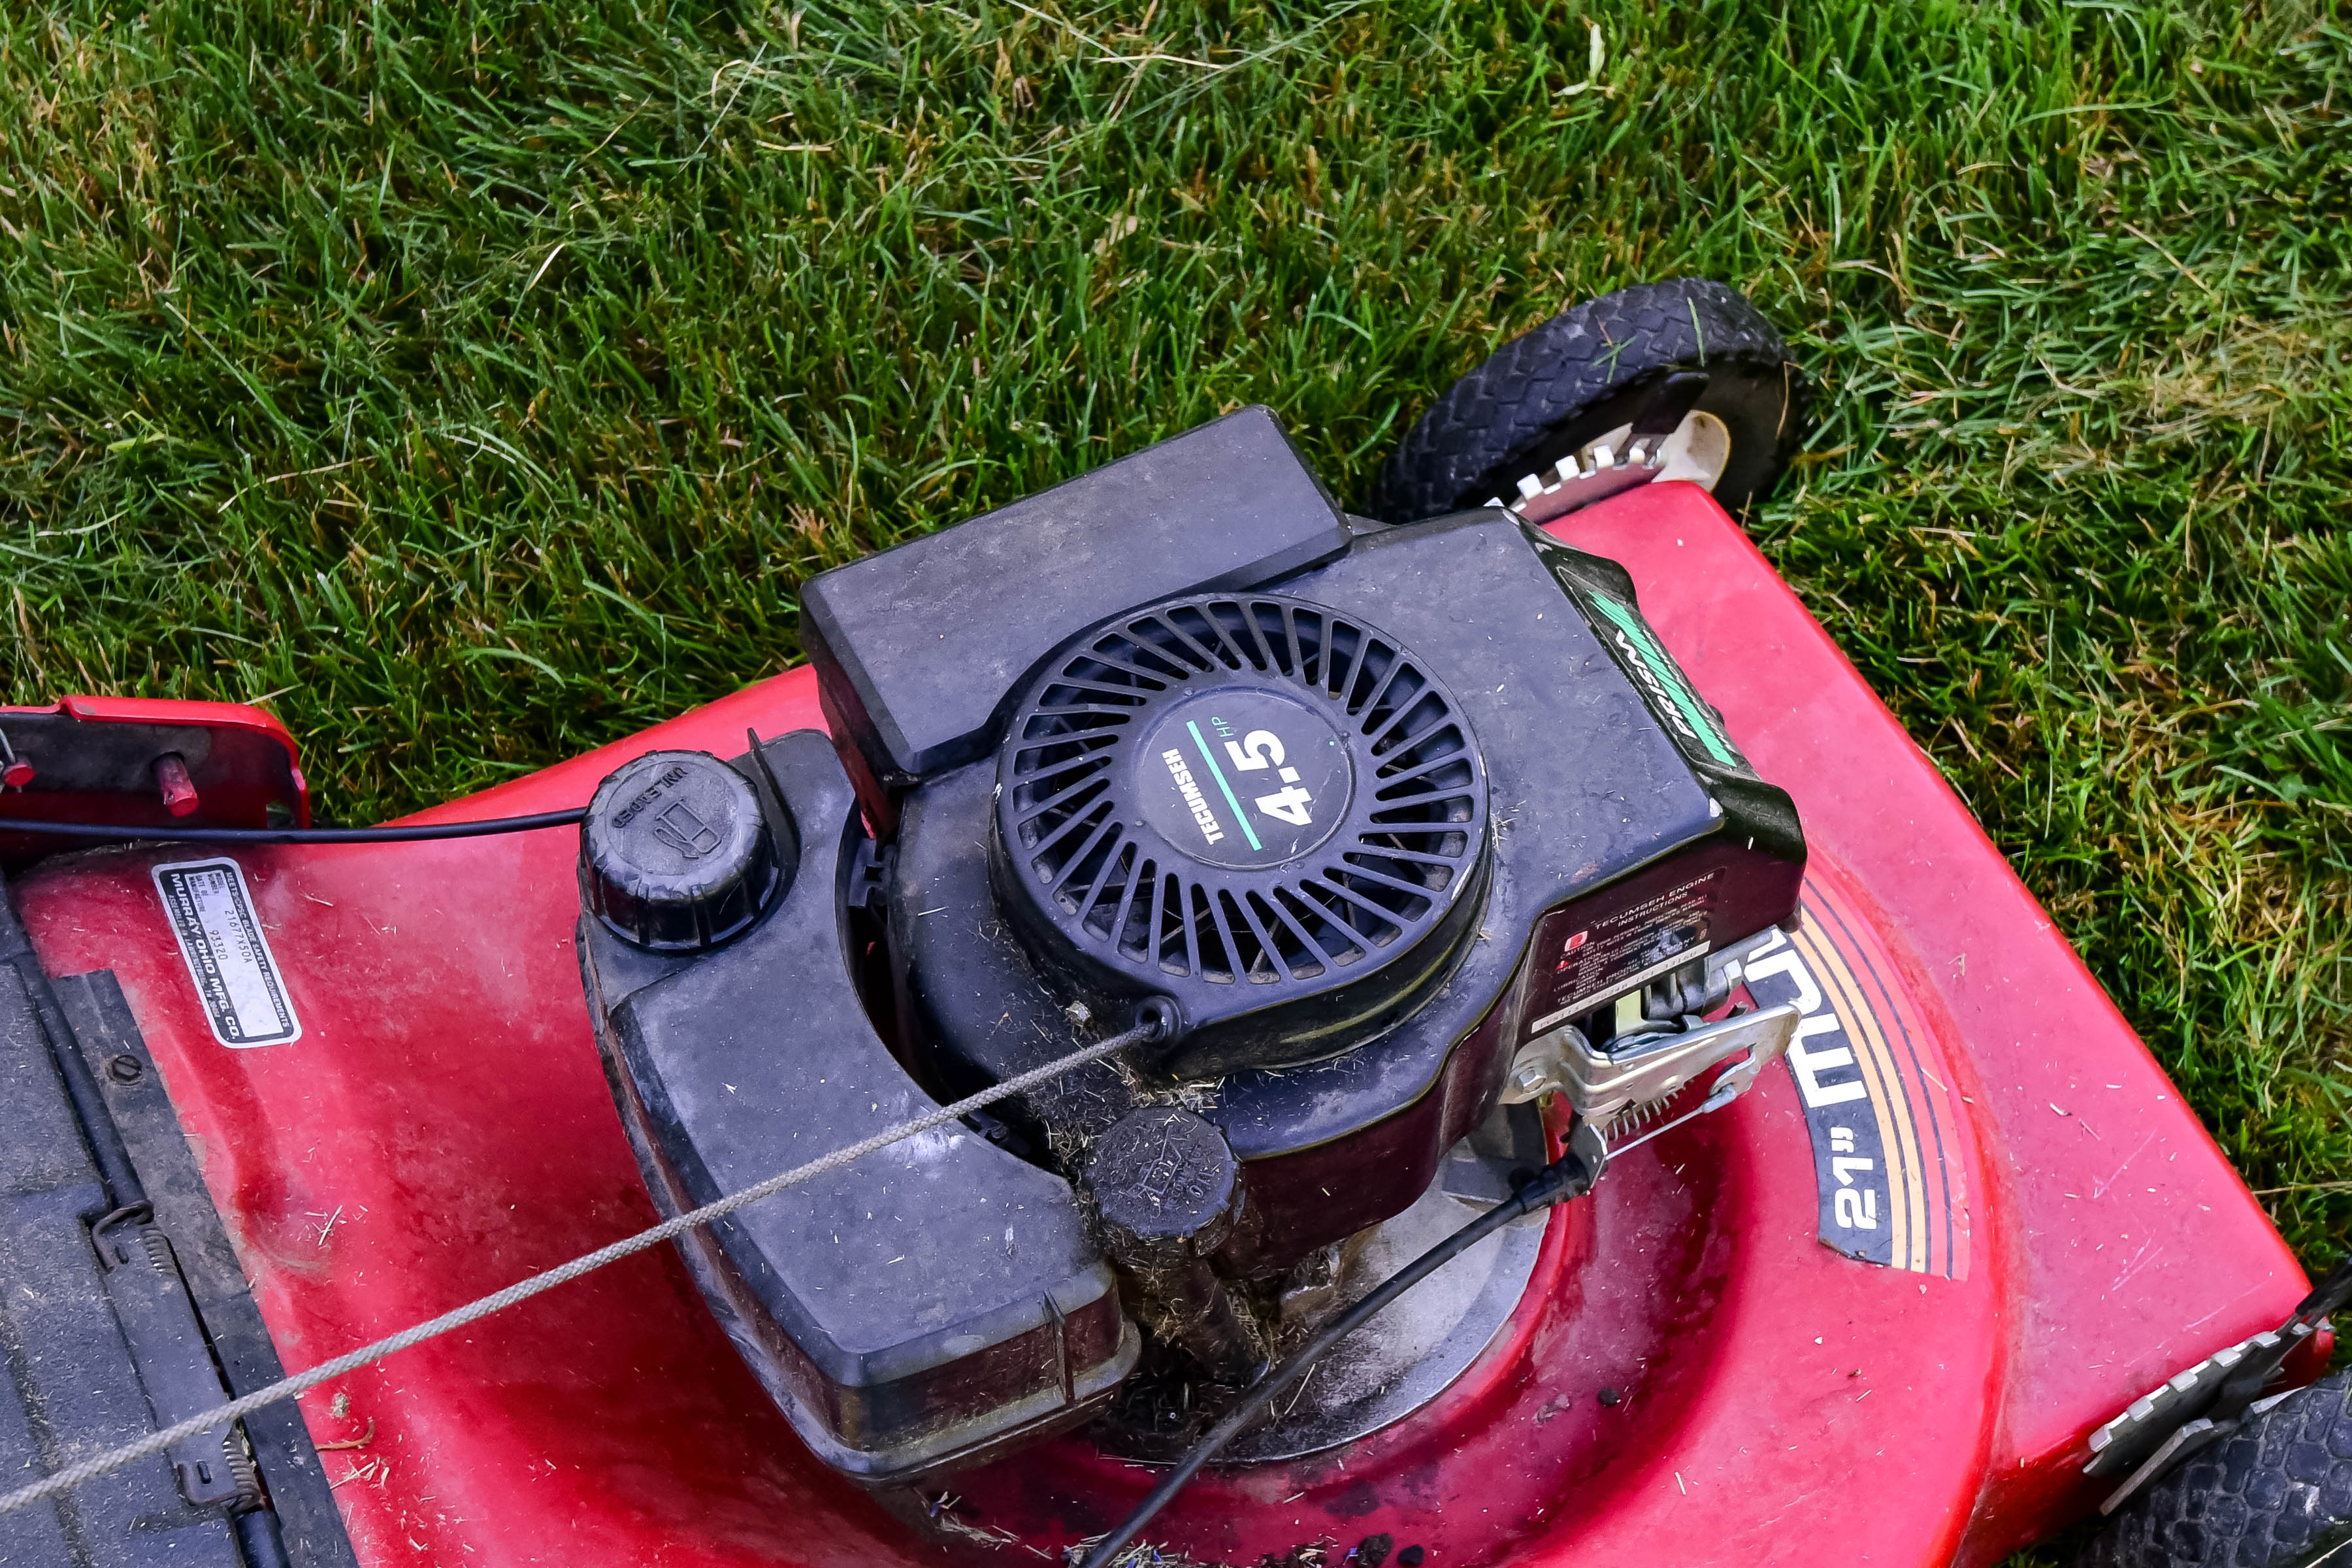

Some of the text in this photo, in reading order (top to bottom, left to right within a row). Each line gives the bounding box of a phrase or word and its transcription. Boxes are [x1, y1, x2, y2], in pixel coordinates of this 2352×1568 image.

[1615, 629, 1697, 739] PRISM
[612, 767, 689, 828] UNLEADED
[1162, 748, 1224, 845] TECUMSEH
[1211, 716, 1313, 826] 4.5 HP
[1595, 872, 1715, 930] TECUMSEH ENGINE
[1618, 891, 1688, 927] INSTRUCTIONS
[171, 873, 240, 1039] MURRAY OHIO MFG. CO.
[209, 930, 228, 960] 93320
[225, 872, 289, 1028] MEETS CPSC BLADE SAFETY REQUIREMENTS
[1557, 952, 1602, 974] OPERATION
[1560, 941, 1595, 959] CAUTION
[1553, 967, 1603, 992] LUBRICATION
[1558, 979, 1603, 1003] TECUMSEH
[1607, 956, 1651, 983] PRODUCTS
[1743, 928, 1878, 1230] 21" MU
